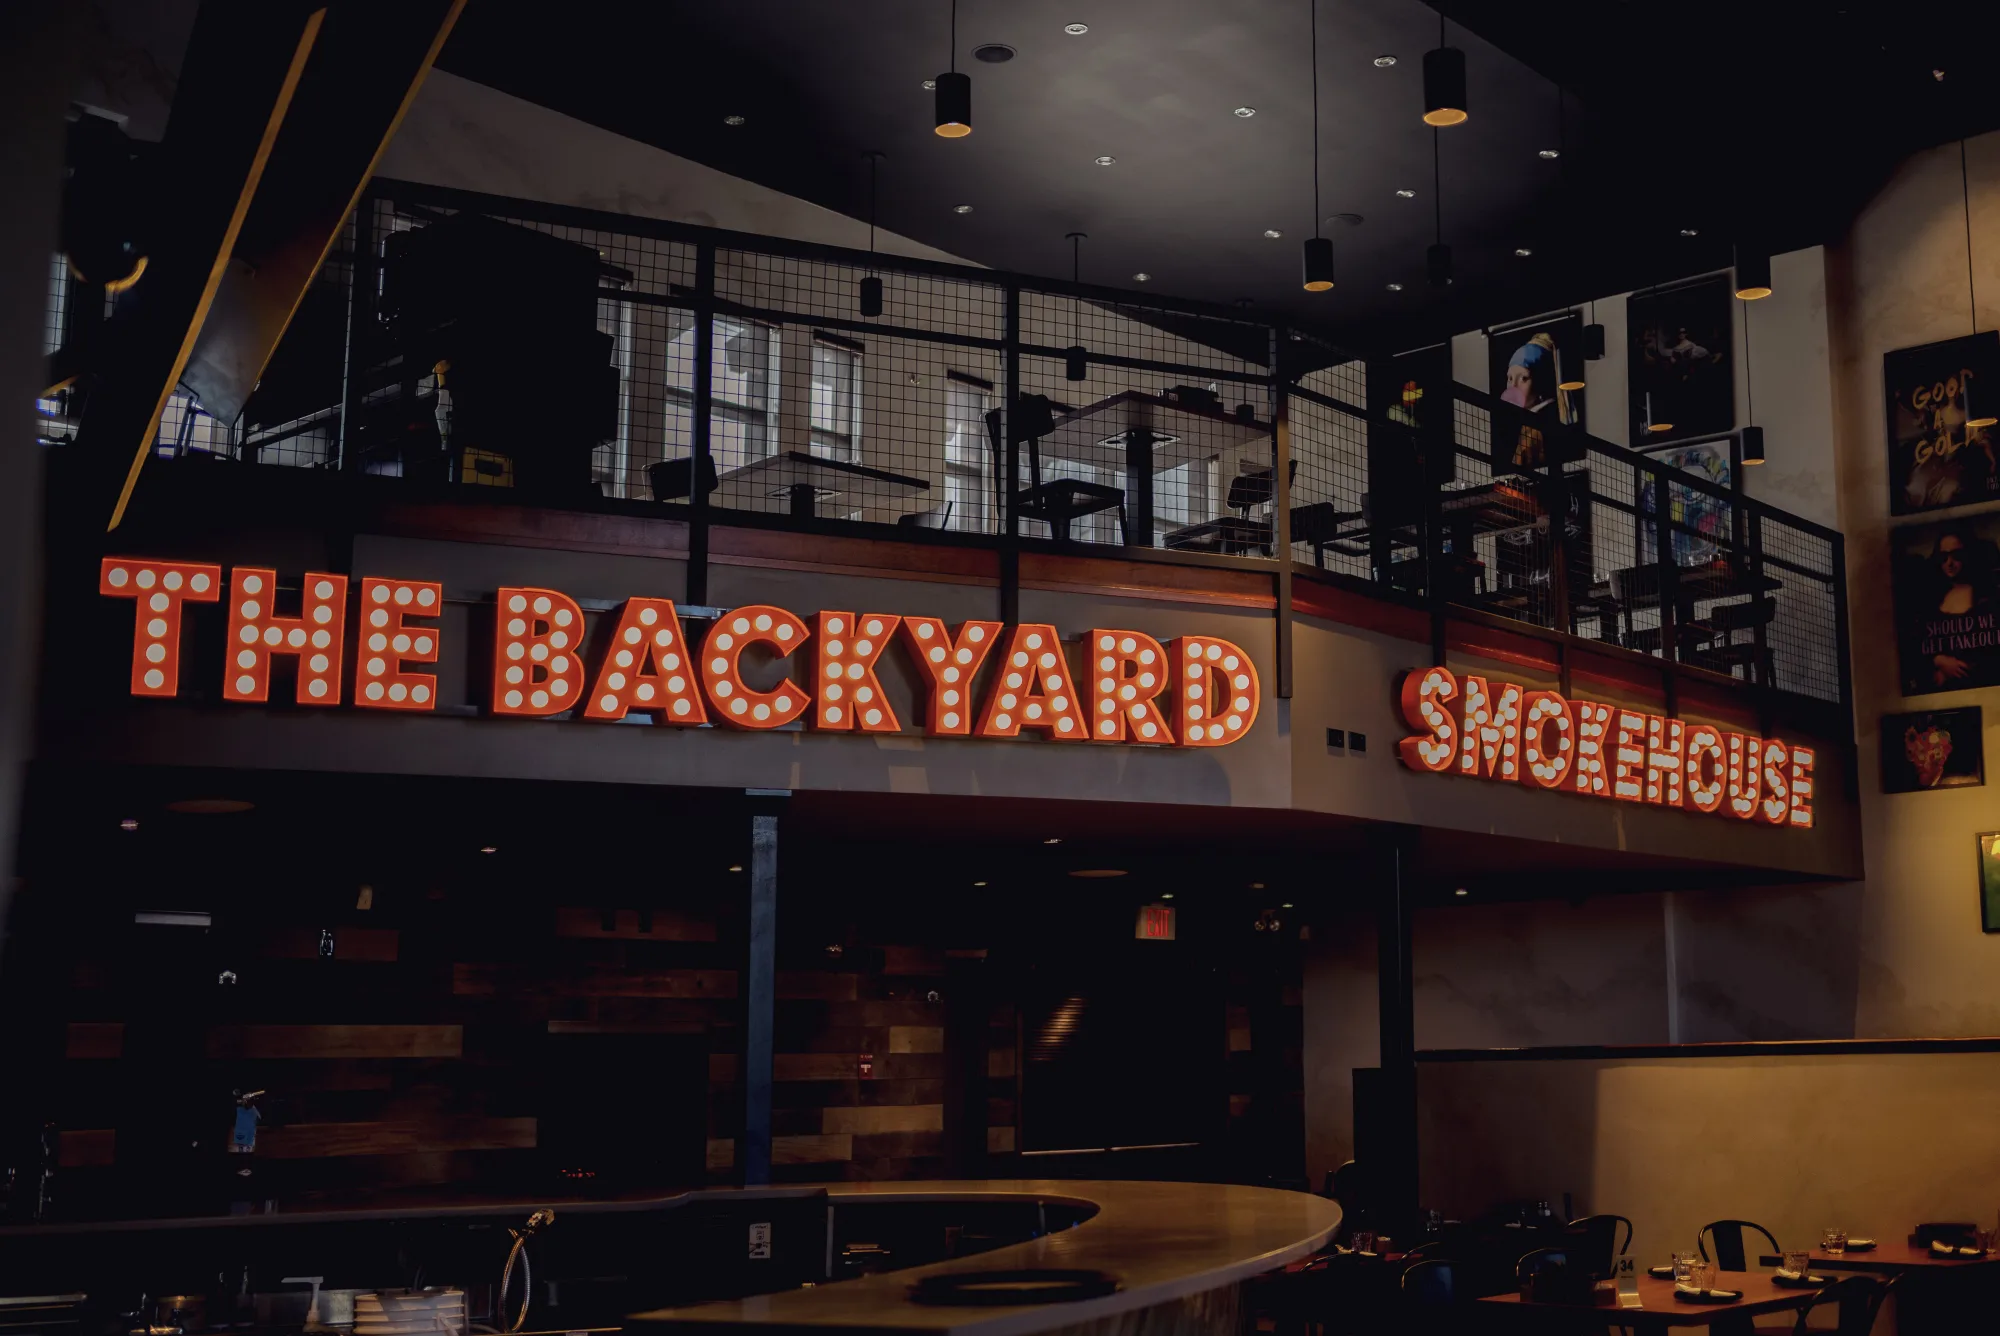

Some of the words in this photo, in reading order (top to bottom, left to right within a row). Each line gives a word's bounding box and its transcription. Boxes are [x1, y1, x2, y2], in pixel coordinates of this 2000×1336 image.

[1926, 616, 1974, 638] SHOULD
[1978, 613, 1997, 629] WE
[99, 556, 443, 711] THE
[492, 586, 1260, 748] BACKYARD
[1921, 637, 1943, 655] GET
[1399, 665, 1816, 829] SMOKEHOUSE
[1147, 908, 1171, 937] EXIT
[1620, 1259, 1634, 1272] 34
